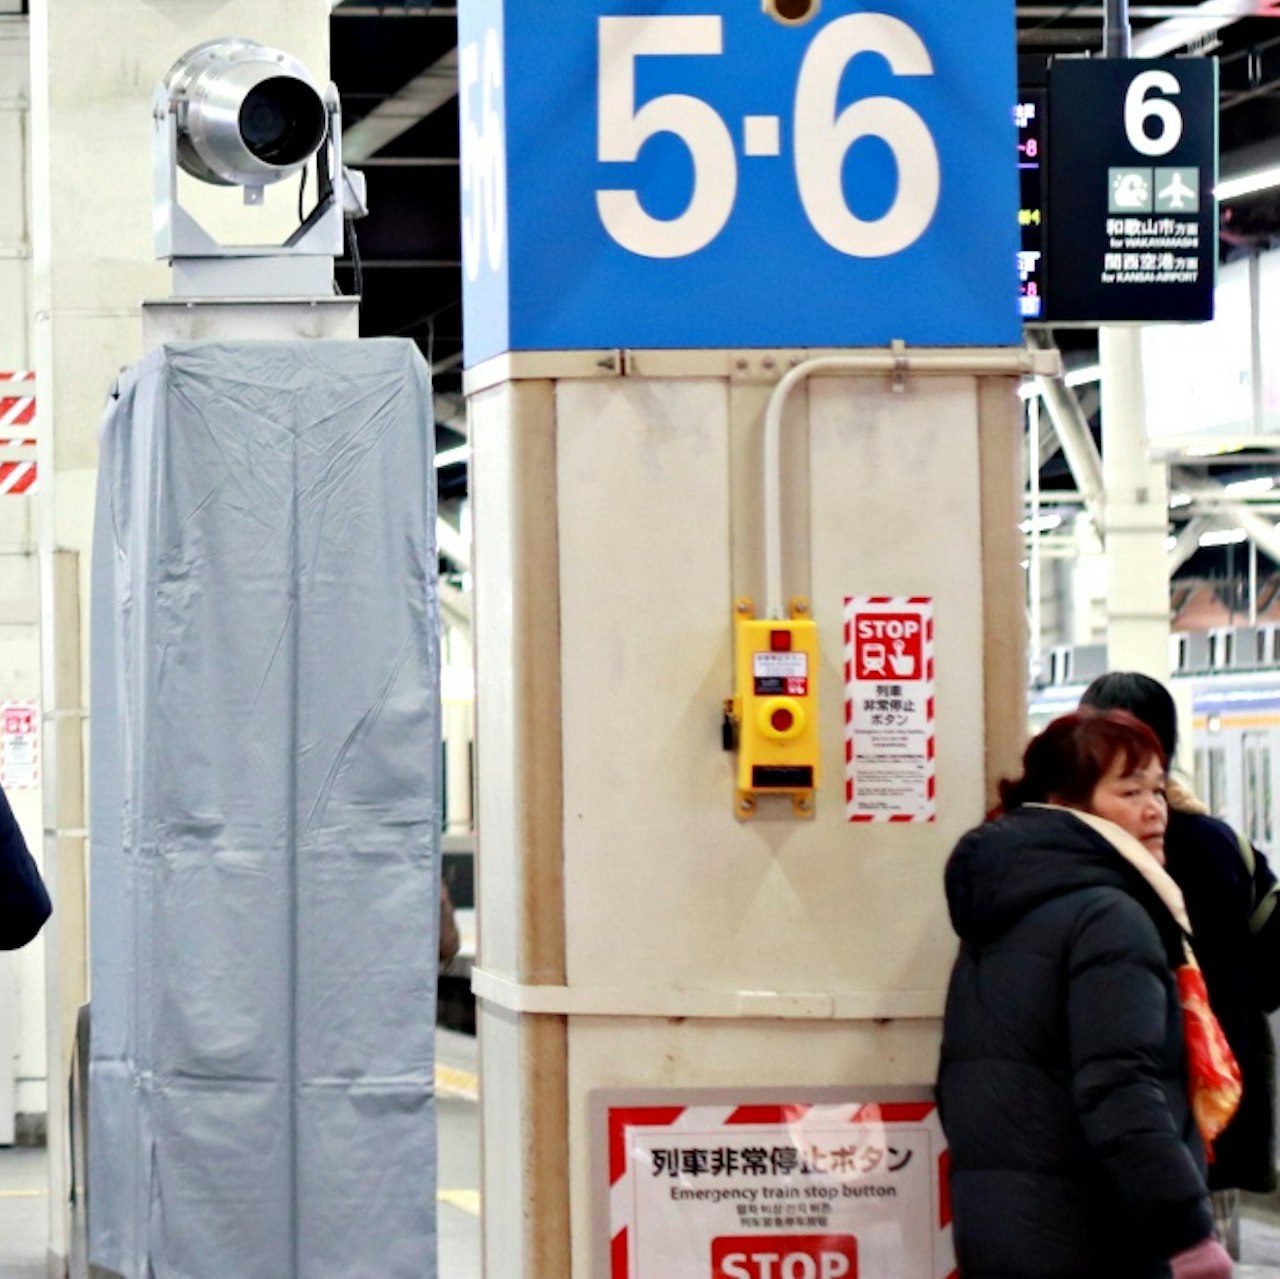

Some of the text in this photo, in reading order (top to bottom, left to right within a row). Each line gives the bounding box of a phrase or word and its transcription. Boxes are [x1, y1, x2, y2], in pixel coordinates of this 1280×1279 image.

[1124, 70, 1183, 157] 6
[1106, 218, 1199, 237] 和歌山市方面
[858, 621, 919, 638] STOP
[876, 685, 902, 697] 列車
[863, 699, 916, 712] 非常停止
[871, 714, 908, 727] ボタン
[651, 1147, 913, 1177] 列車非常停止ボタン
[670, 1184, 897, 1202] Emergency train stop button
[721, 1253, 849, 1279] STOP
